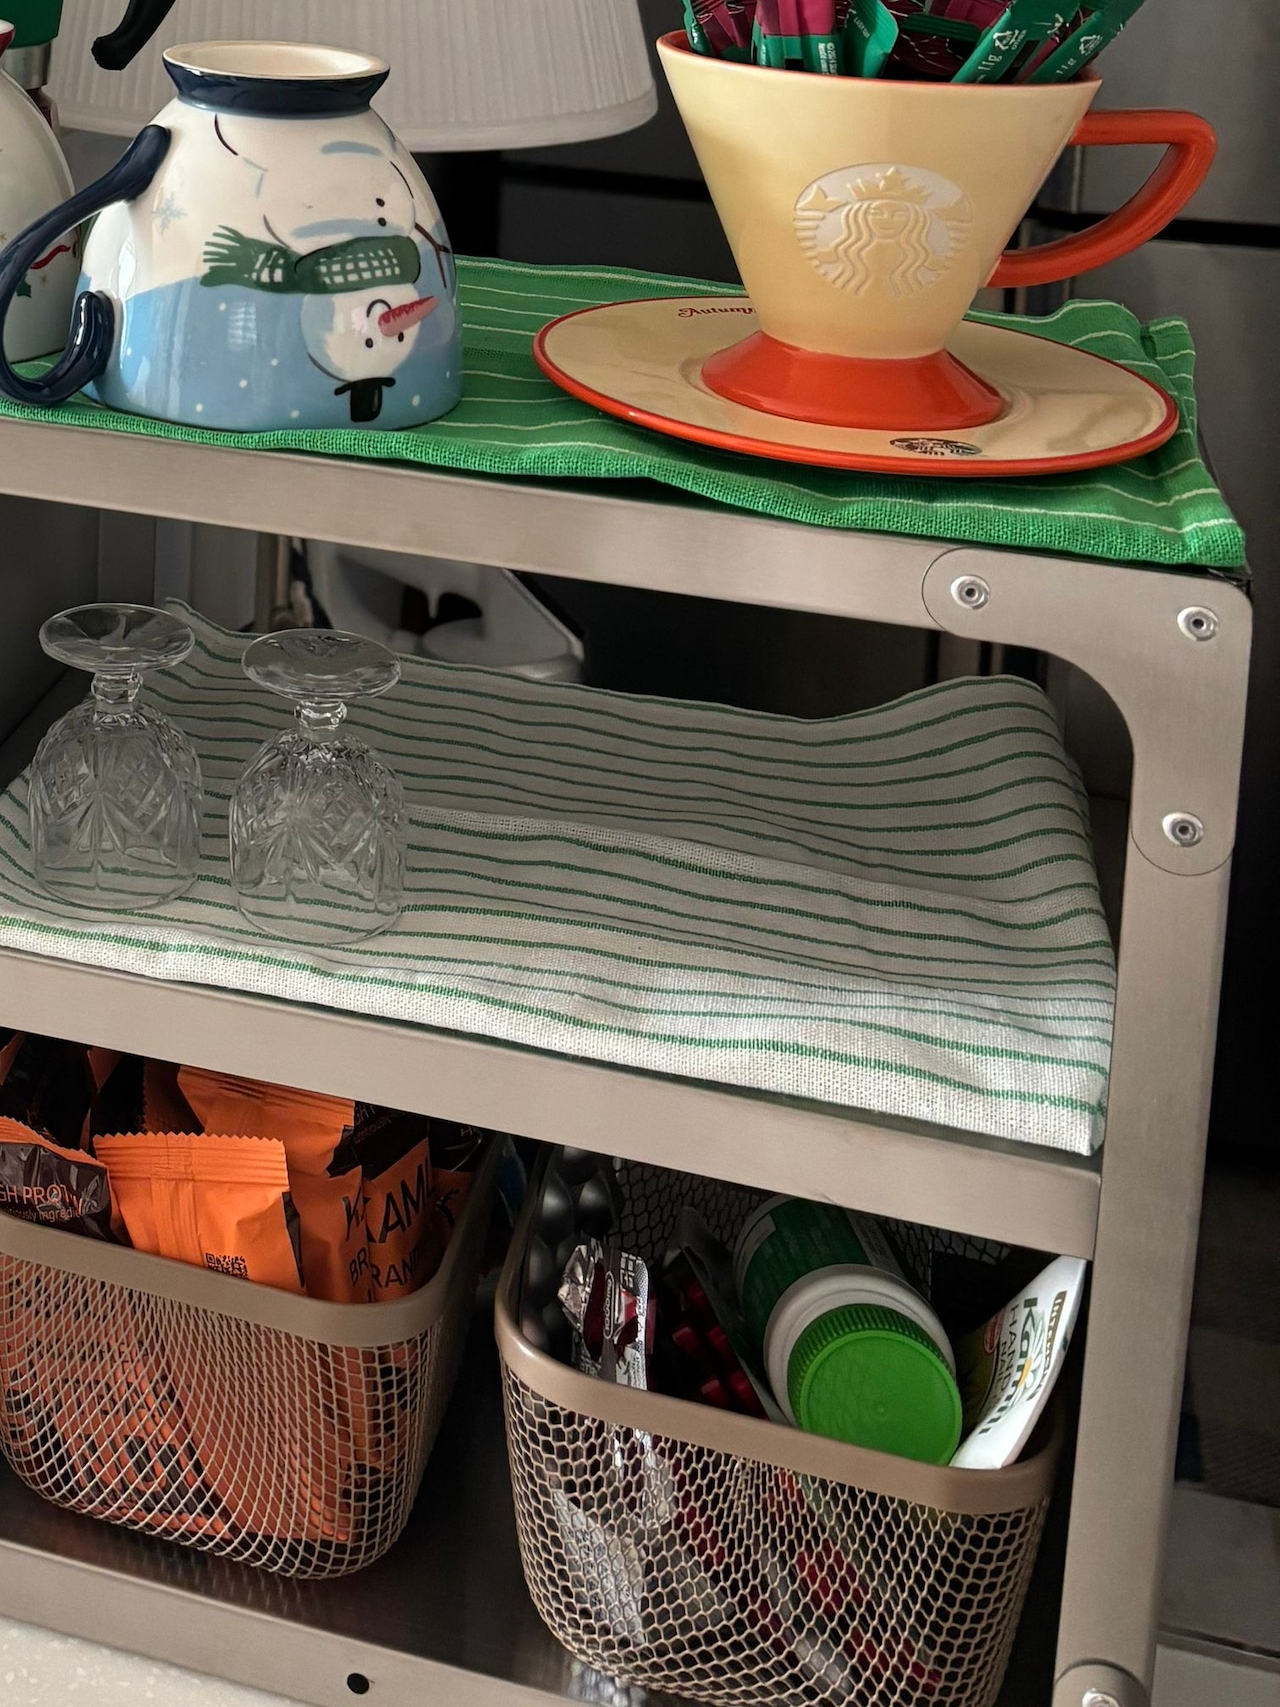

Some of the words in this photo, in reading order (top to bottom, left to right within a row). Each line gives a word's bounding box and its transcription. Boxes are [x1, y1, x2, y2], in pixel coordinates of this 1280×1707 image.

[977, 54, 1003, 71] 11g
[979, 1297, 1038, 1434] Kamill
[1001, 1304, 1019, 1392] HAND
